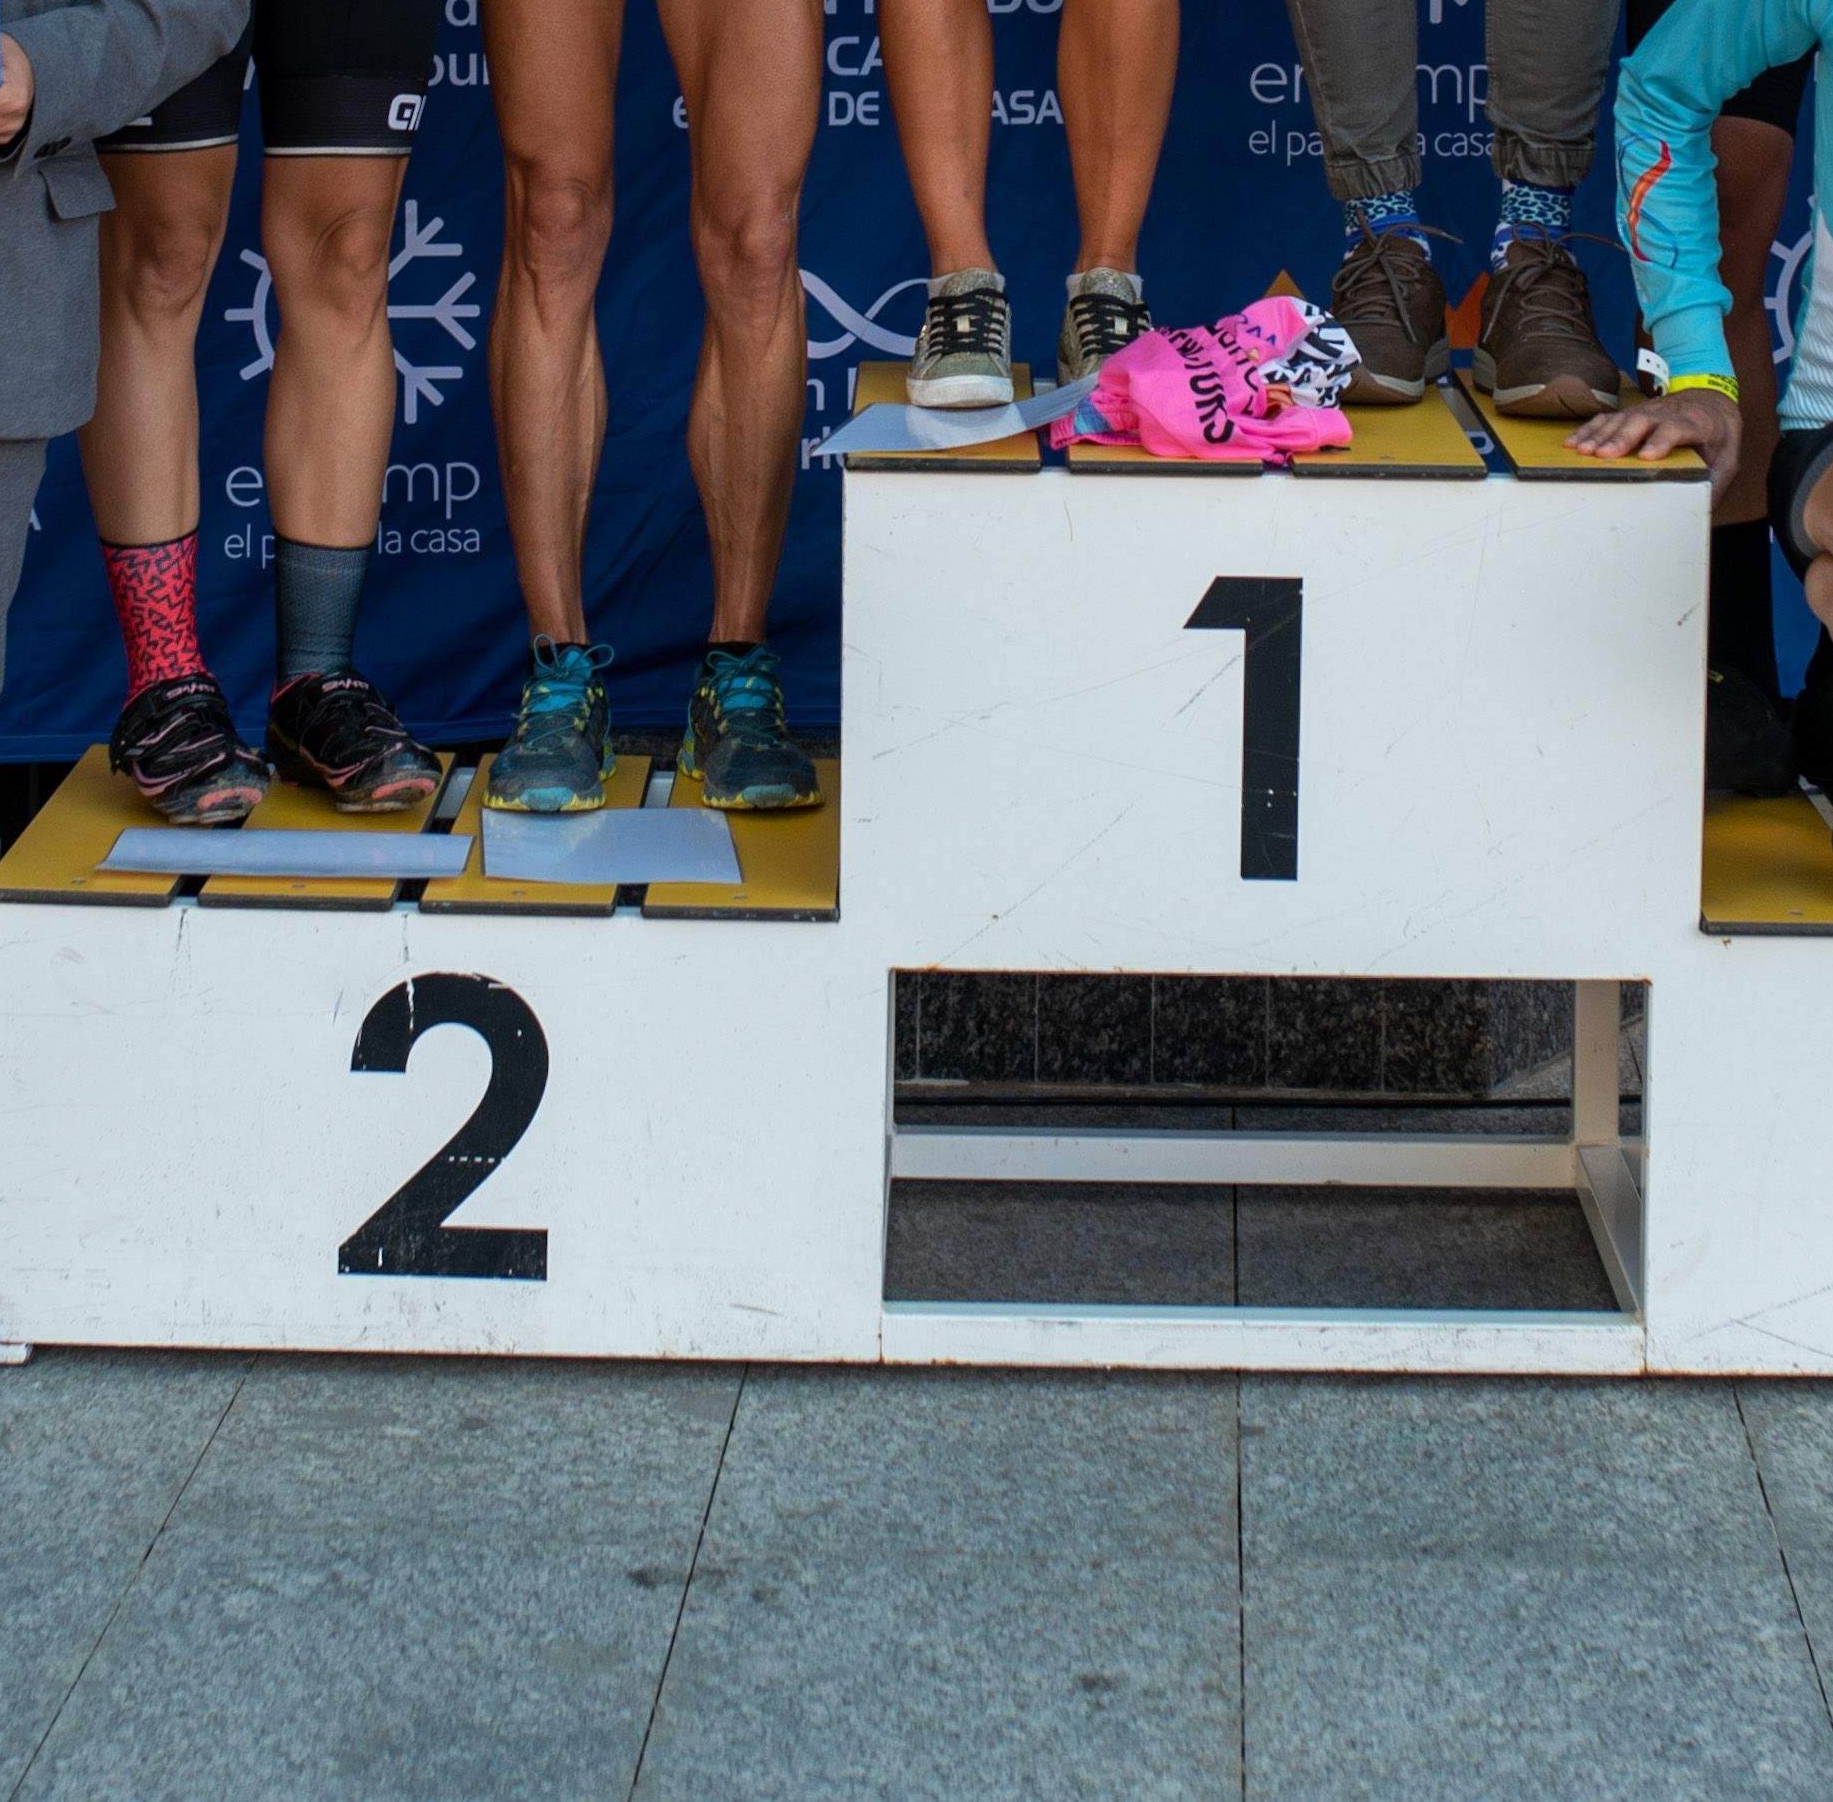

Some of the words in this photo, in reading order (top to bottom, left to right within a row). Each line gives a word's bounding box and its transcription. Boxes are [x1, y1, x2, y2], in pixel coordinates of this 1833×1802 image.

[989, 91, 1065, 125] ASA
[1248, 121, 1277, 155] el
[1286, 131, 1324, 166] pa
[224, 523, 251, 559] el
[378, 521, 402, 555] la
[410, 528, 480, 554] casa
[1184, 576, 1303, 881] 1
[337, 972, 550, 1282] 2
